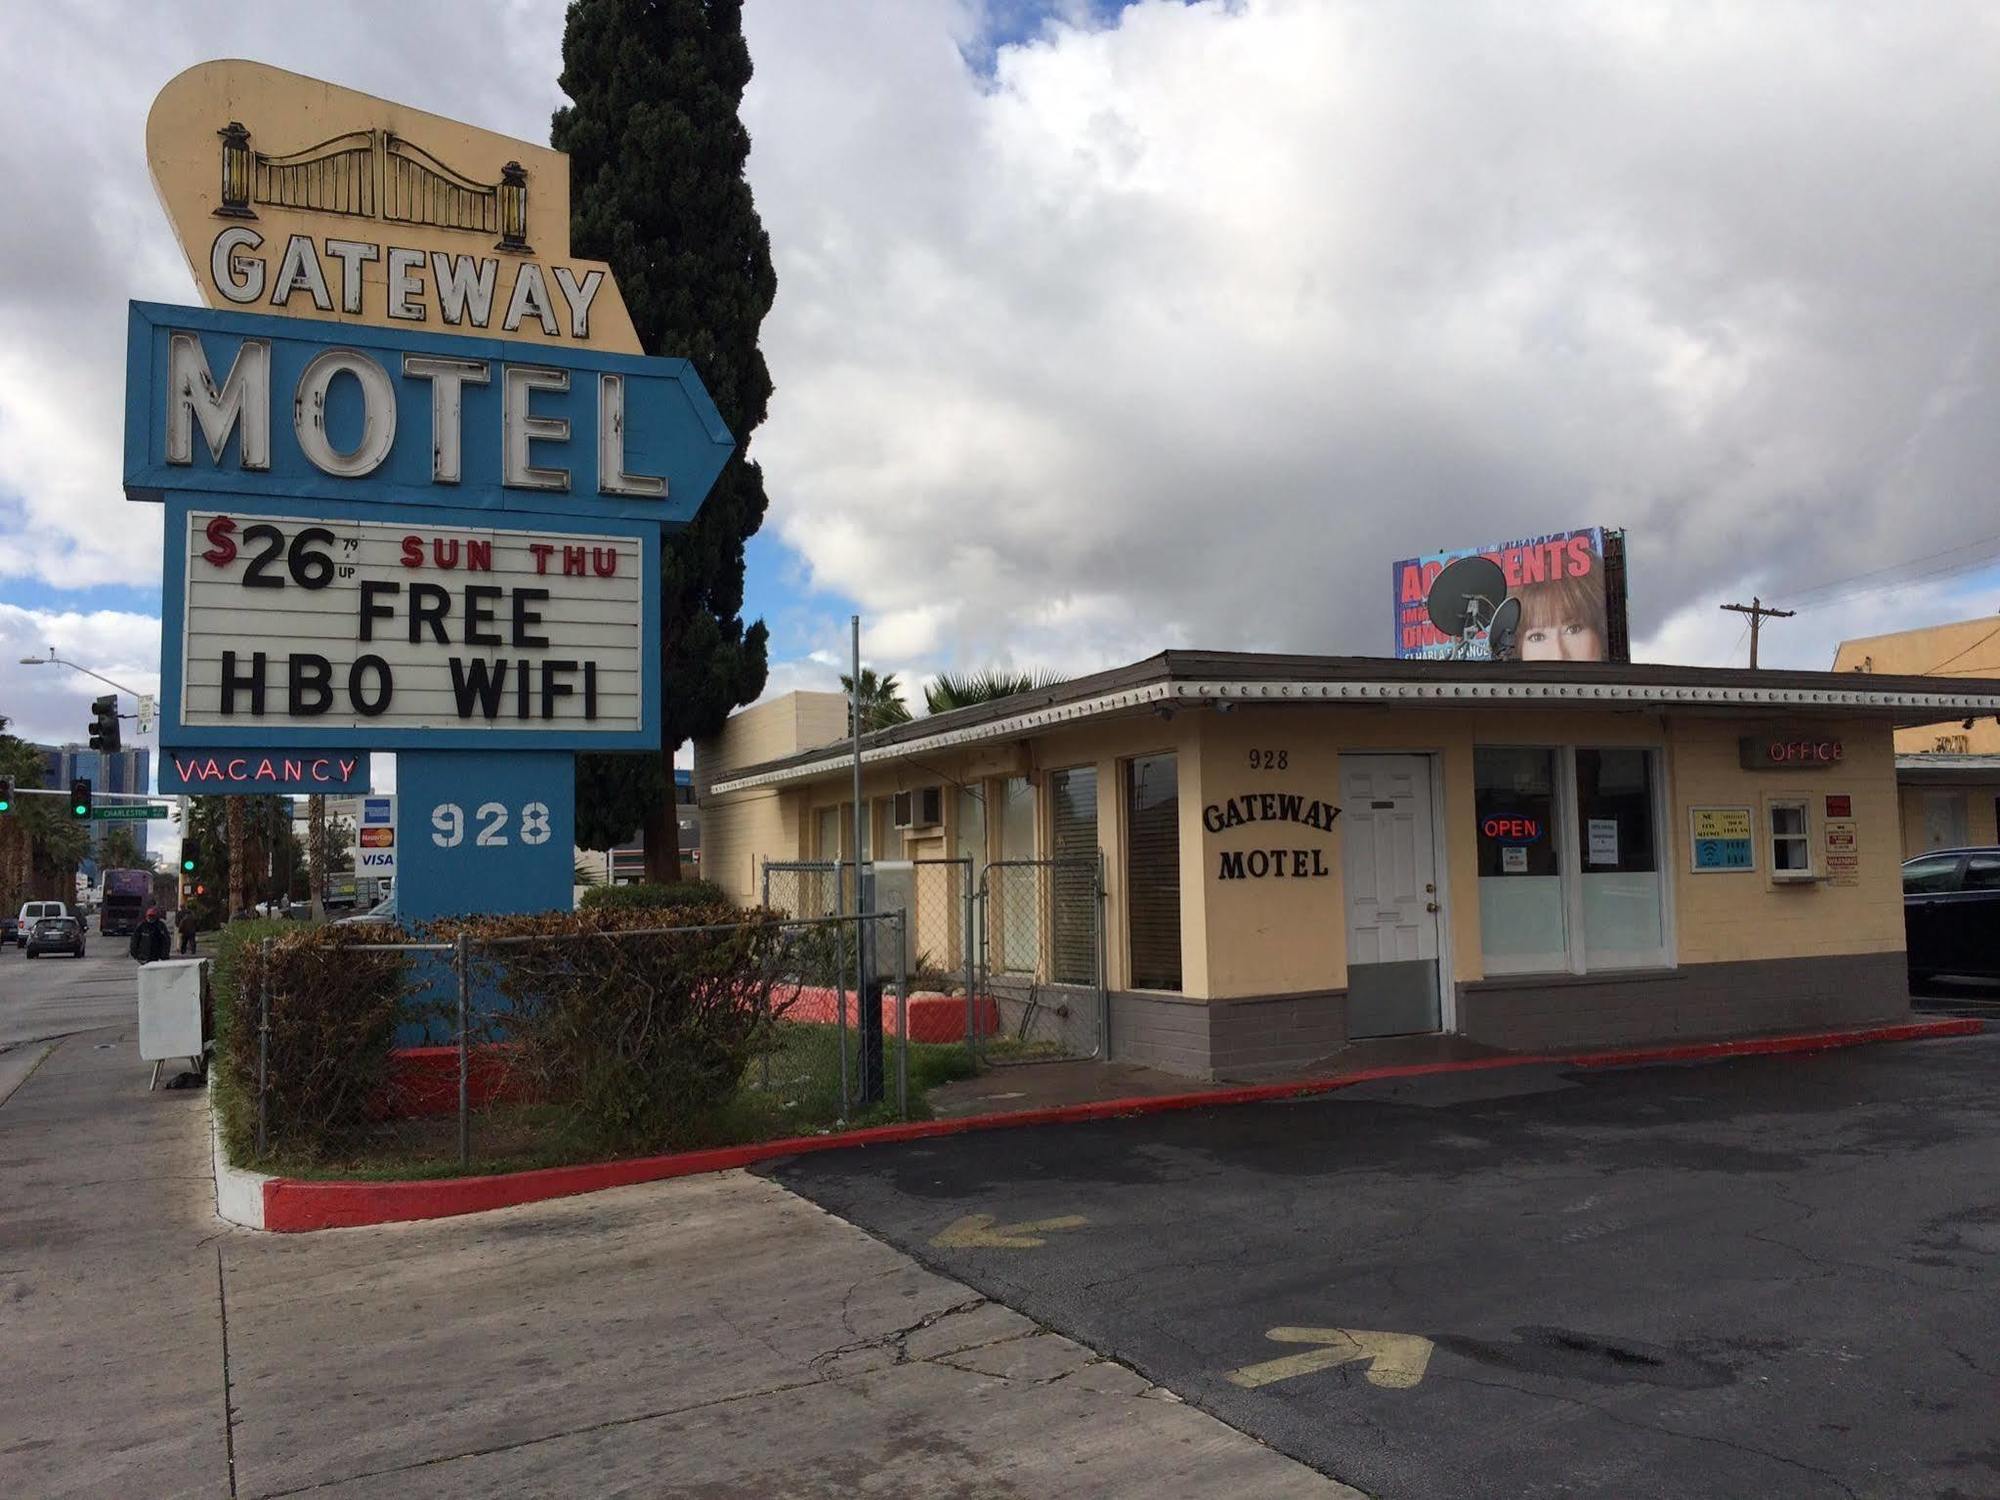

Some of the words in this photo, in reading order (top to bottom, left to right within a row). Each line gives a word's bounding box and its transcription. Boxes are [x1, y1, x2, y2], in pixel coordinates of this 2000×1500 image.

[210, 226, 605, 339] GATEWAY
[165, 329, 669, 498] MOTEL
[202, 515, 335, 590] $26
[400, 535, 491, 571] SUN
[529, 543, 616, 577] THU
[338, 566, 356, 579] UP
[360, 579, 550, 648] FREE
[220, 650, 393, 717] HBO
[449, 656, 597, 720] WIFI
[1248, 748, 1289, 770] 928
[1770, 741, 1846, 761] OFFICE
[174, 757, 357, 783] VACANCY
[431, 801, 552, 848] 928
[1202, 793, 1342, 833] GATEWAY
[1484, 820, 1536, 837] OPEN
[361, 853, 394, 866] VISA
[1218, 849, 1329, 879] MOTEL
